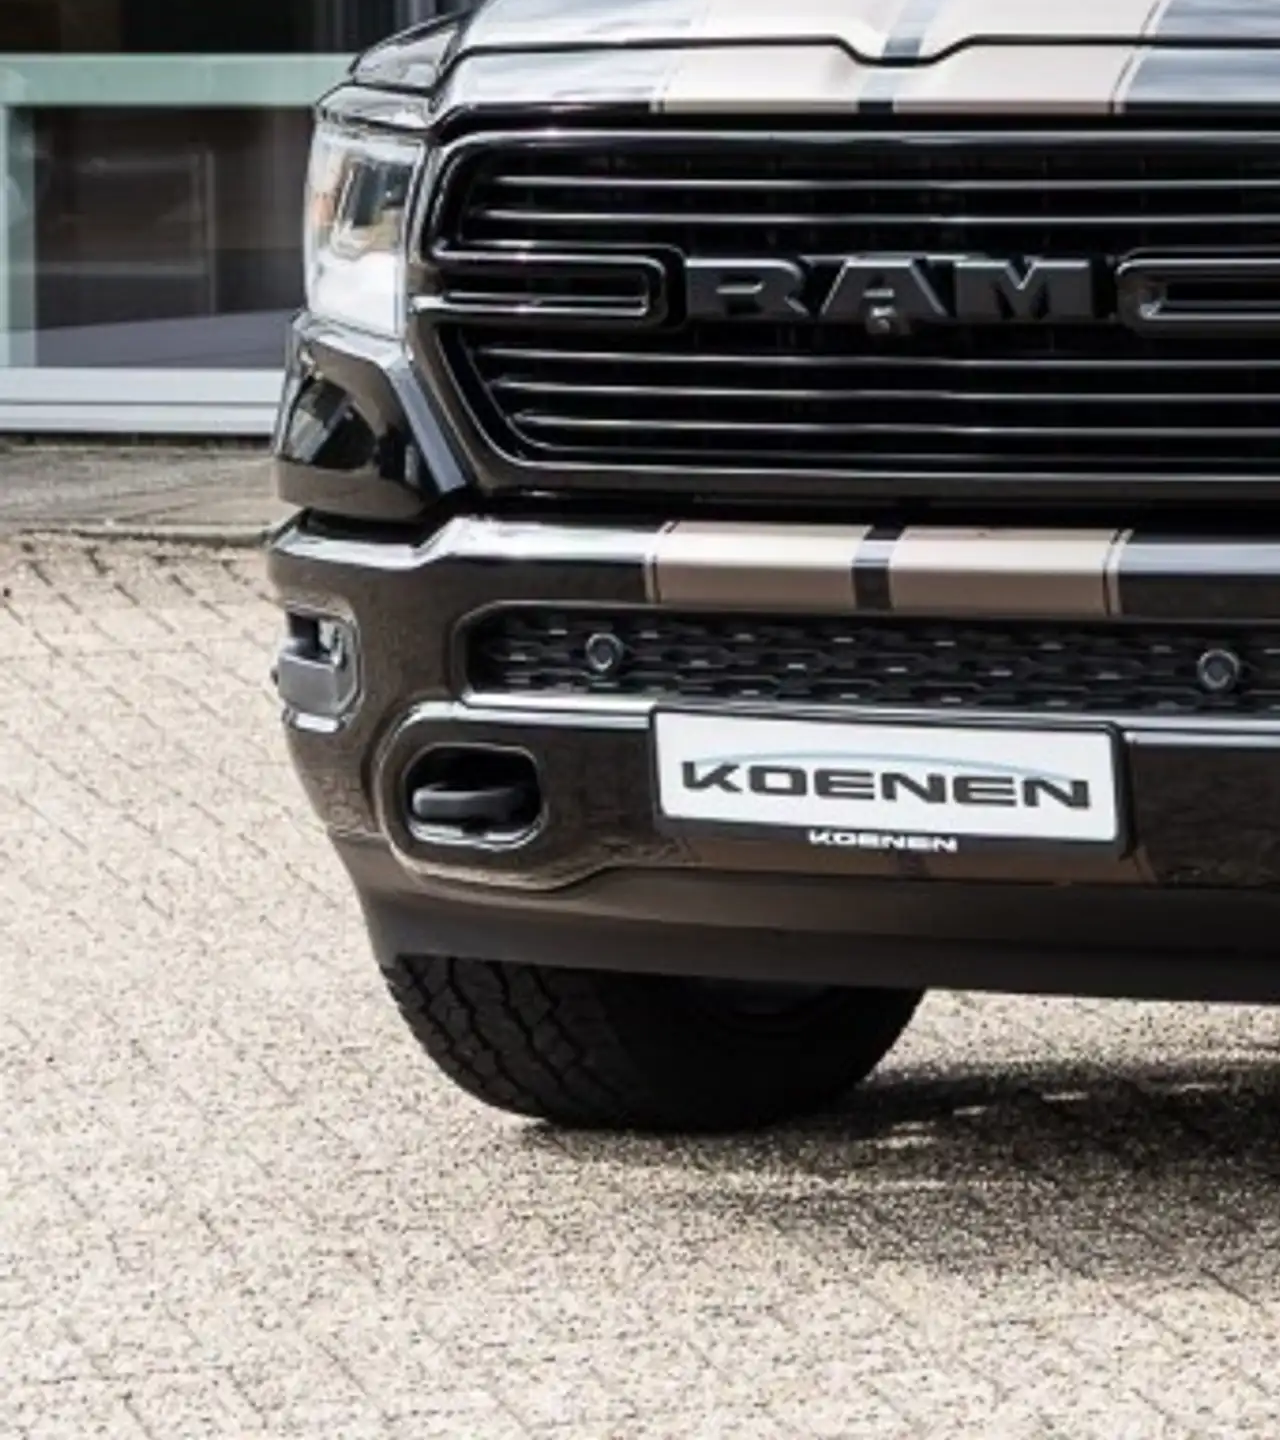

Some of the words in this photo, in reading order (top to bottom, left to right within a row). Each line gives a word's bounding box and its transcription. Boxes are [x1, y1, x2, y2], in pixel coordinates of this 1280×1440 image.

[684, 257, 1095, 320] RAM
[682, 760, 1090, 810] KOENEN
[808, 829, 958, 853] KOENEN
